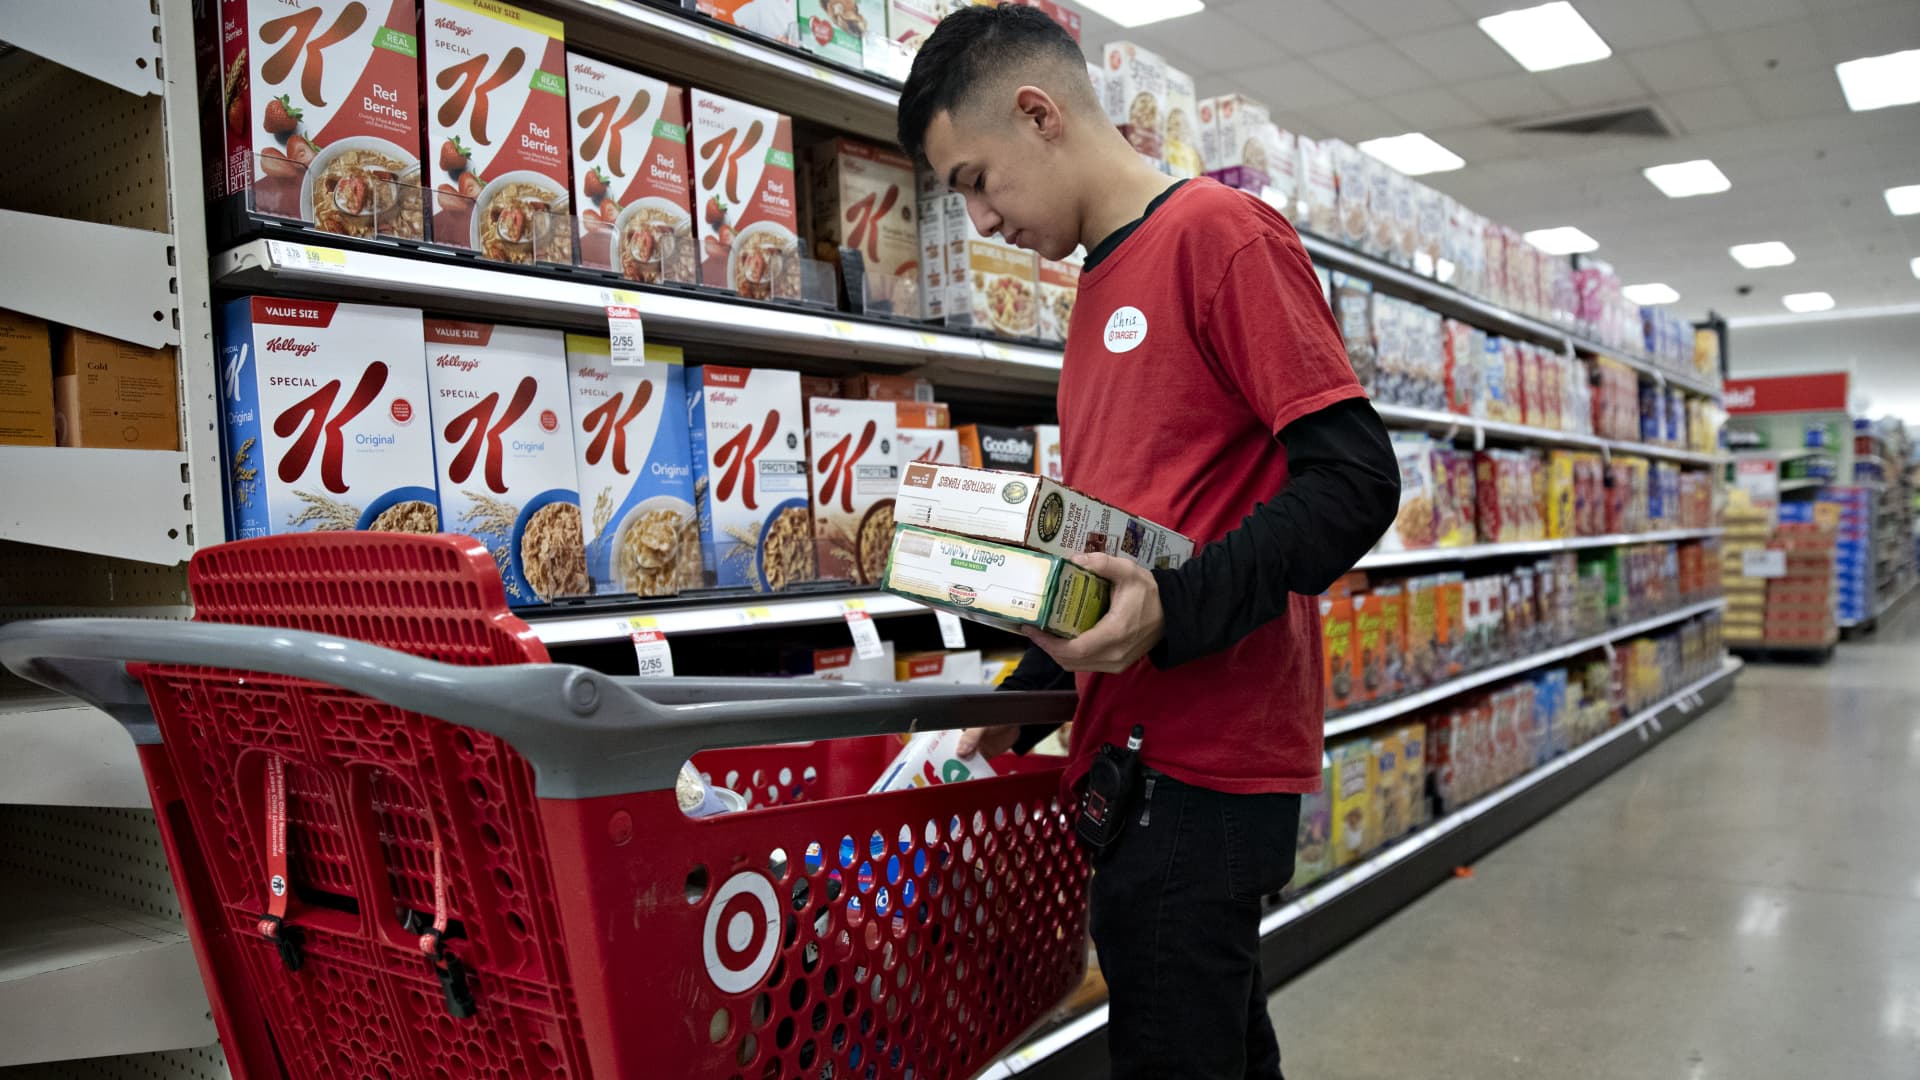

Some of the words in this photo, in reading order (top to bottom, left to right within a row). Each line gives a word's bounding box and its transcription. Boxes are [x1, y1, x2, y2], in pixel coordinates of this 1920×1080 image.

[473, 0, 503, 15] FAMILY
[503, 7, 521, 21] SIZE
[434, 16, 474, 37] Kellogg's
[386, 33, 410, 49] REAL
[434, 39, 472, 56] SPECIAL
[258, 1, 368, 108] K
[540, 74, 560, 90] REAL
[575, 83, 607, 98] SPECIAL
[372, 83, 398, 102] Red
[435, 46, 526, 146] K
[363, 97, 408, 121] Berries
[529, 122, 550, 138] Red
[577, 89, 651, 178] K
[521, 134, 559, 156] Berries
[656, 153, 675, 169] Red
[700, 120, 764, 205] K
[650, 164, 682, 183] Berries
[265, 306, 297, 318] VALUE
[298, 308, 320, 320] SIZE
[1112, 312, 1137, 329] Chris
[435, 327, 461, 338] VALUE
[461, 329, 480, 340] SIZE
[612, 335, 634, 347] 2/$5
[1114, 330, 1139, 340] TARGET
[266, 336, 320, 358] Kellogg's
[436, 353, 481, 372] Kellogg's
[269, 376, 318, 388] SPECIAL
[439, 388, 481, 400] SPECIAL
[579, 388, 609, 398] SPECIAL
[273, 361, 389, 495] K
[444, 376, 538, 495] K
[582, 379, 653, 475] K
[355, 433, 395, 448] Original
[512, 439, 545, 454] Original
[713, 409, 780, 511] K
[761, 464, 796, 473] PROTEIN
[817, 420, 877, 514] K
[650, 462, 689, 479] Original
[640, 658, 663, 671] 2/$5
